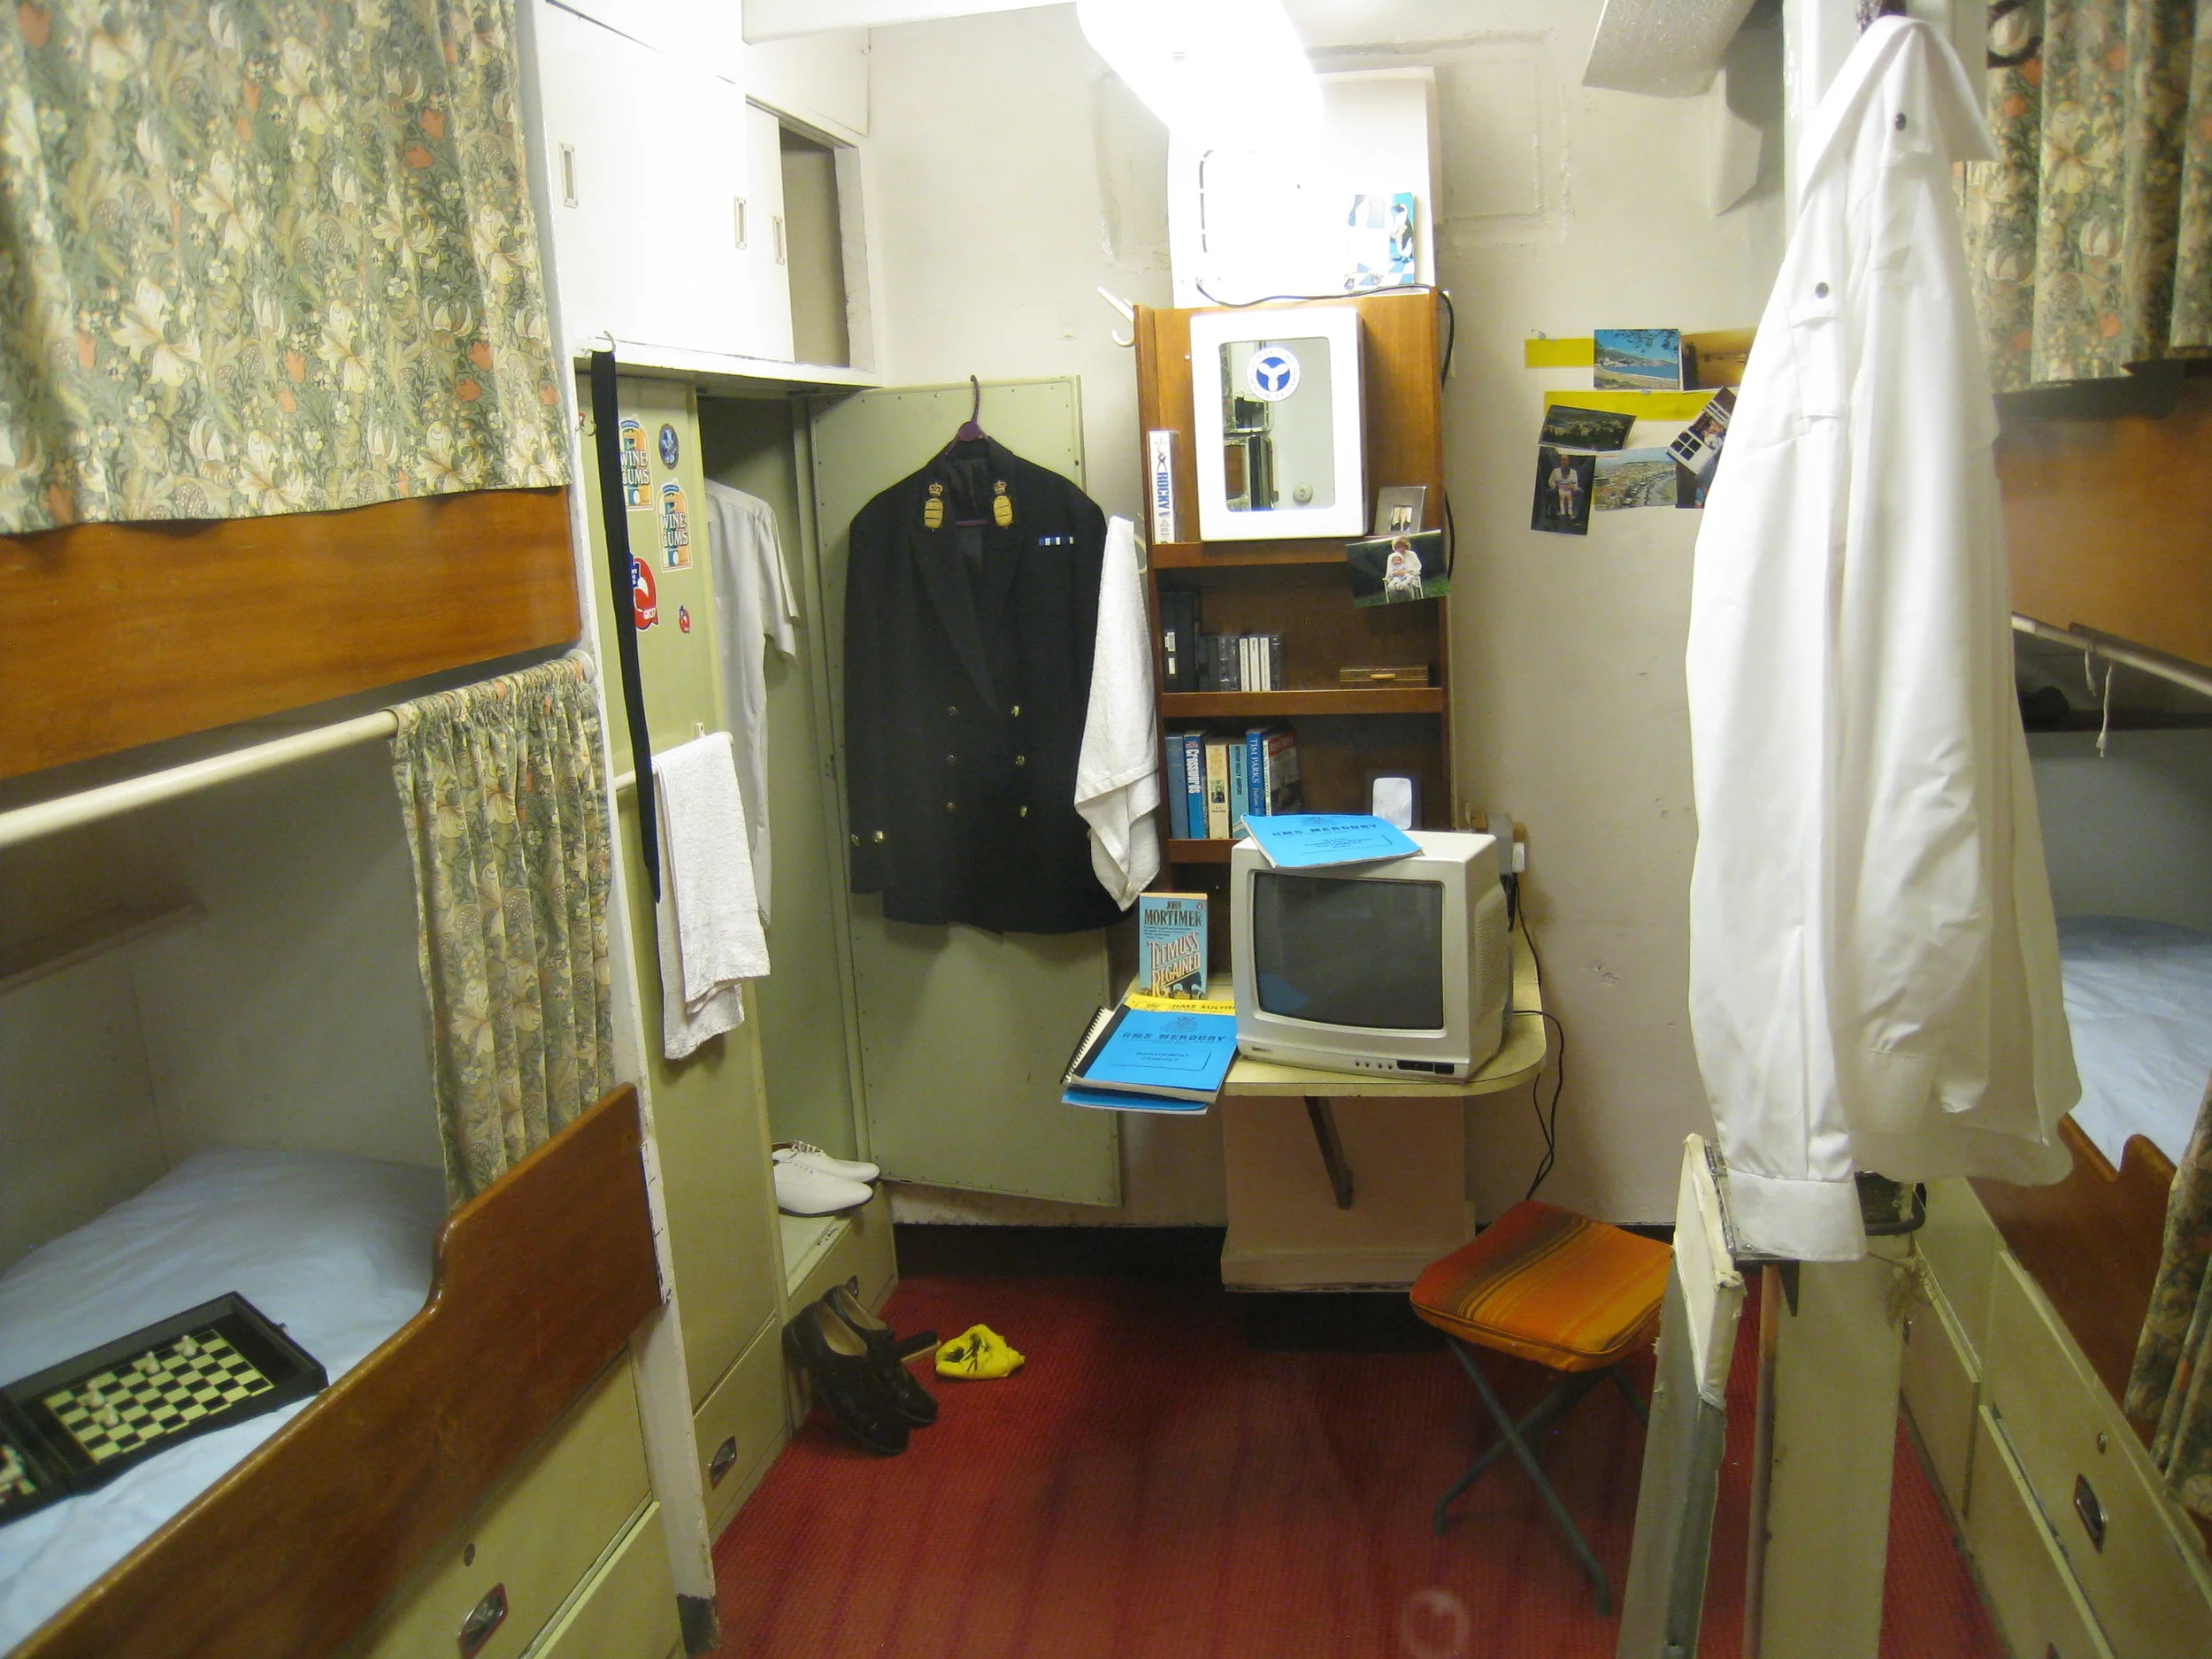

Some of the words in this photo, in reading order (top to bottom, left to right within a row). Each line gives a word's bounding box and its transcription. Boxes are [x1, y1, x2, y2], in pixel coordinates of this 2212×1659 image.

[620, 450, 648, 467] WINE
[621, 468, 650, 486] GUMS
[1156, 472, 1170, 508] ROCKY
[660, 513, 687, 529] WINE
[661, 530, 689, 547] GUMS
[1186, 749, 1200, 794] Crosswords
[1251, 757, 1260, 784] PARKS
[1310, 824, 1378, 833] MERCURY
[1166, 901, 1182, 910] JOHN
[1144, 909, 1202, 927] MORTIMER
[1147, 930, 1200, 970] TITMUSS
[1151, 952, 1201, 997] REGAINED
